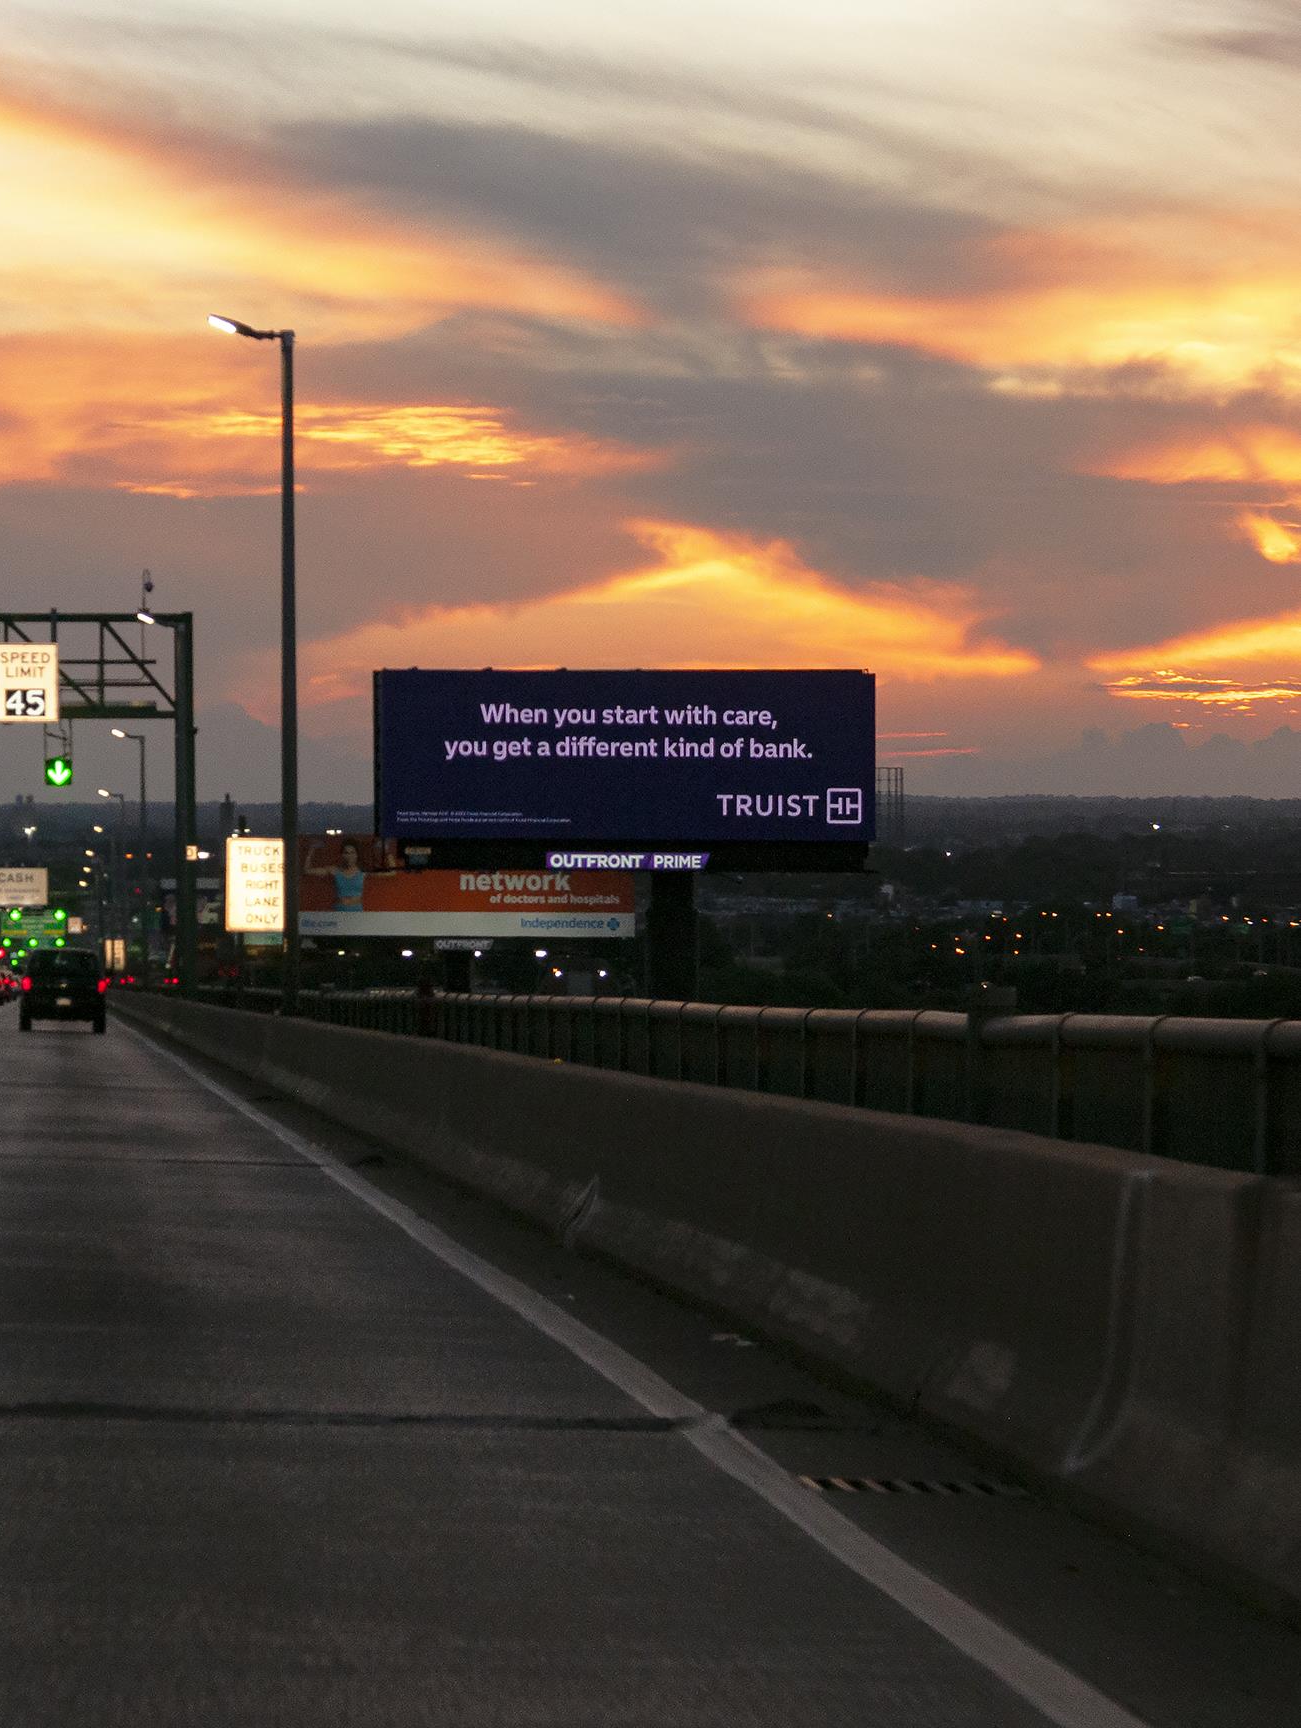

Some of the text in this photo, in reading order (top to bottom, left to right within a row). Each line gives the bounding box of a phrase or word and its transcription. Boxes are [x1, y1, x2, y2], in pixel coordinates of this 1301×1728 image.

[0, 652, 50, 664] SPEED
[5, 666, 45, 678] LIMIT
[6, 689, 45, 716] 45
[479, 703, 778, 730] When you start with care,
[444, 736, 813, 761] you get a different kind of bank.
[717, 793, 820, 818] TRUIST
[237, 846, 280, 856] TRUCK
[240, 863, 285, 873] BUSES
[550, 854, 703, 870] OUTFRONT PRIME
[246, 880, 279, 890] RIGHT
[459, 872, 571, 891] network
[245, 896, 280, 907] LANE
[489, 893, 620, 906] of doctors and hospitals
[245, 913, 279, 924] ONLY
[520, 917, 605, 931] Independence
[436, 940, 493, 950] OUTFRONT
